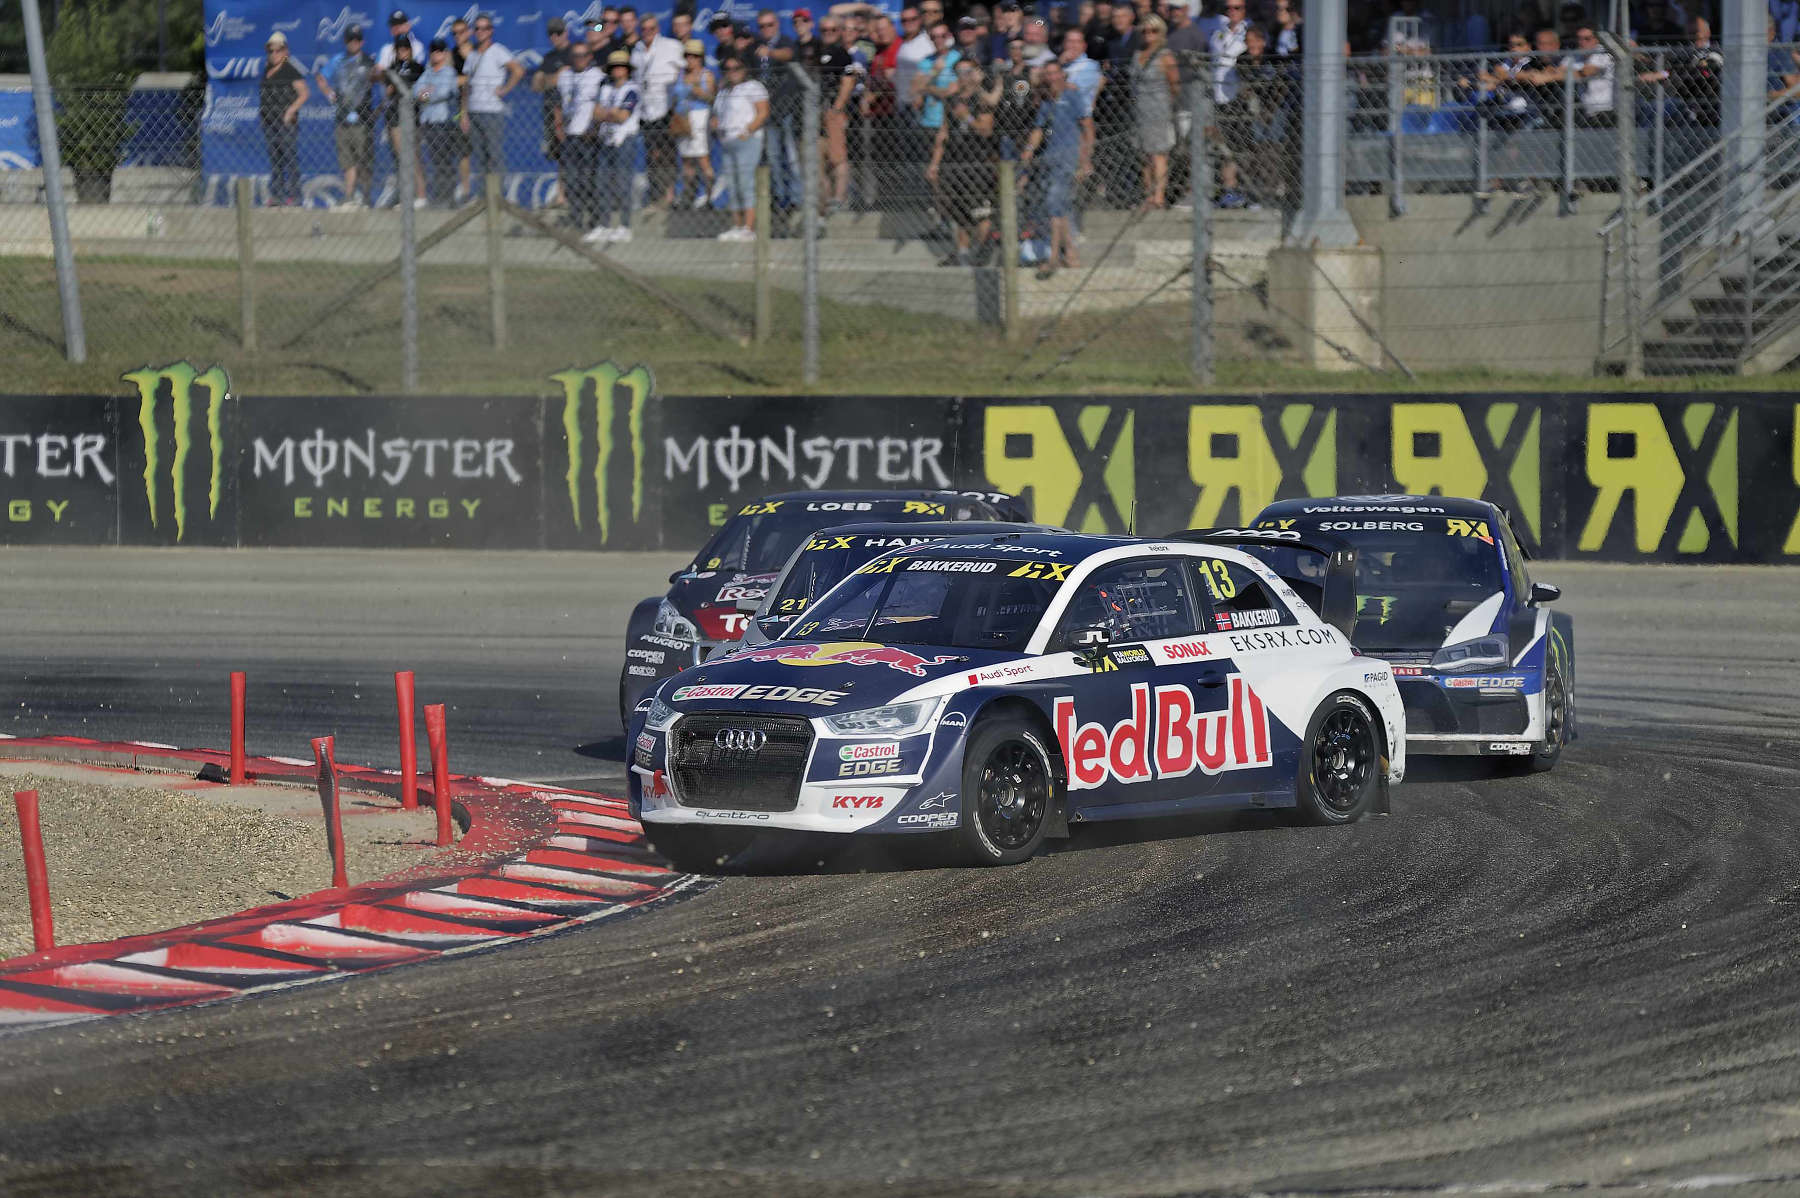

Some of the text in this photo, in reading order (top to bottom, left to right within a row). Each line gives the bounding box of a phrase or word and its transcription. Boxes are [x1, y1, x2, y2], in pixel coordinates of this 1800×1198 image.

[294, 497, 482, 519] ENERGY
[806, 502, 873, 512] LOEB
[1319, 520, 1425, 532] SOLBERG
[864, 537, 945, 547] HAN
[990, 543, 1064, 559] Sport
[706, 557, 721, 570] 9
[906, 560, 998, 574] BAKKERUD
[1198, 558, 1237, 600] 13
[780, 598, 809, 611] 21
[1230, 608, 1281, 629] BAKKERUD
[795, 621, 820, 636] 13
[640, 634, 692, 652] PEUGEOT
[1229, 627, 1338, 653] EKSRX.COM
[627, 649, 666, 659] COOPER
[1162, 640, 1213, 660] SONAX
[980, 664, 1034, 681] Audi Sport
[1369, 671, 1389, 682] PAGID
[1477, 677, 1526, 688] EDGE
[686, 685, 851, 707] Castrol EDGE
[941, 720, 964, 728] MAN
[1154, 672, 1274, 781] Bull
[853, 744, 896, 759] Castrol
[1489, 743, 1532, 751] COOPER
[838, 759, 903, 777] EDGE
[832, 795, 884, 809] KYB
[696, 810, 770, 820] quattro
[897, 812, 959, 824] COOPER
[927, 819, 958, 828] TIRES
